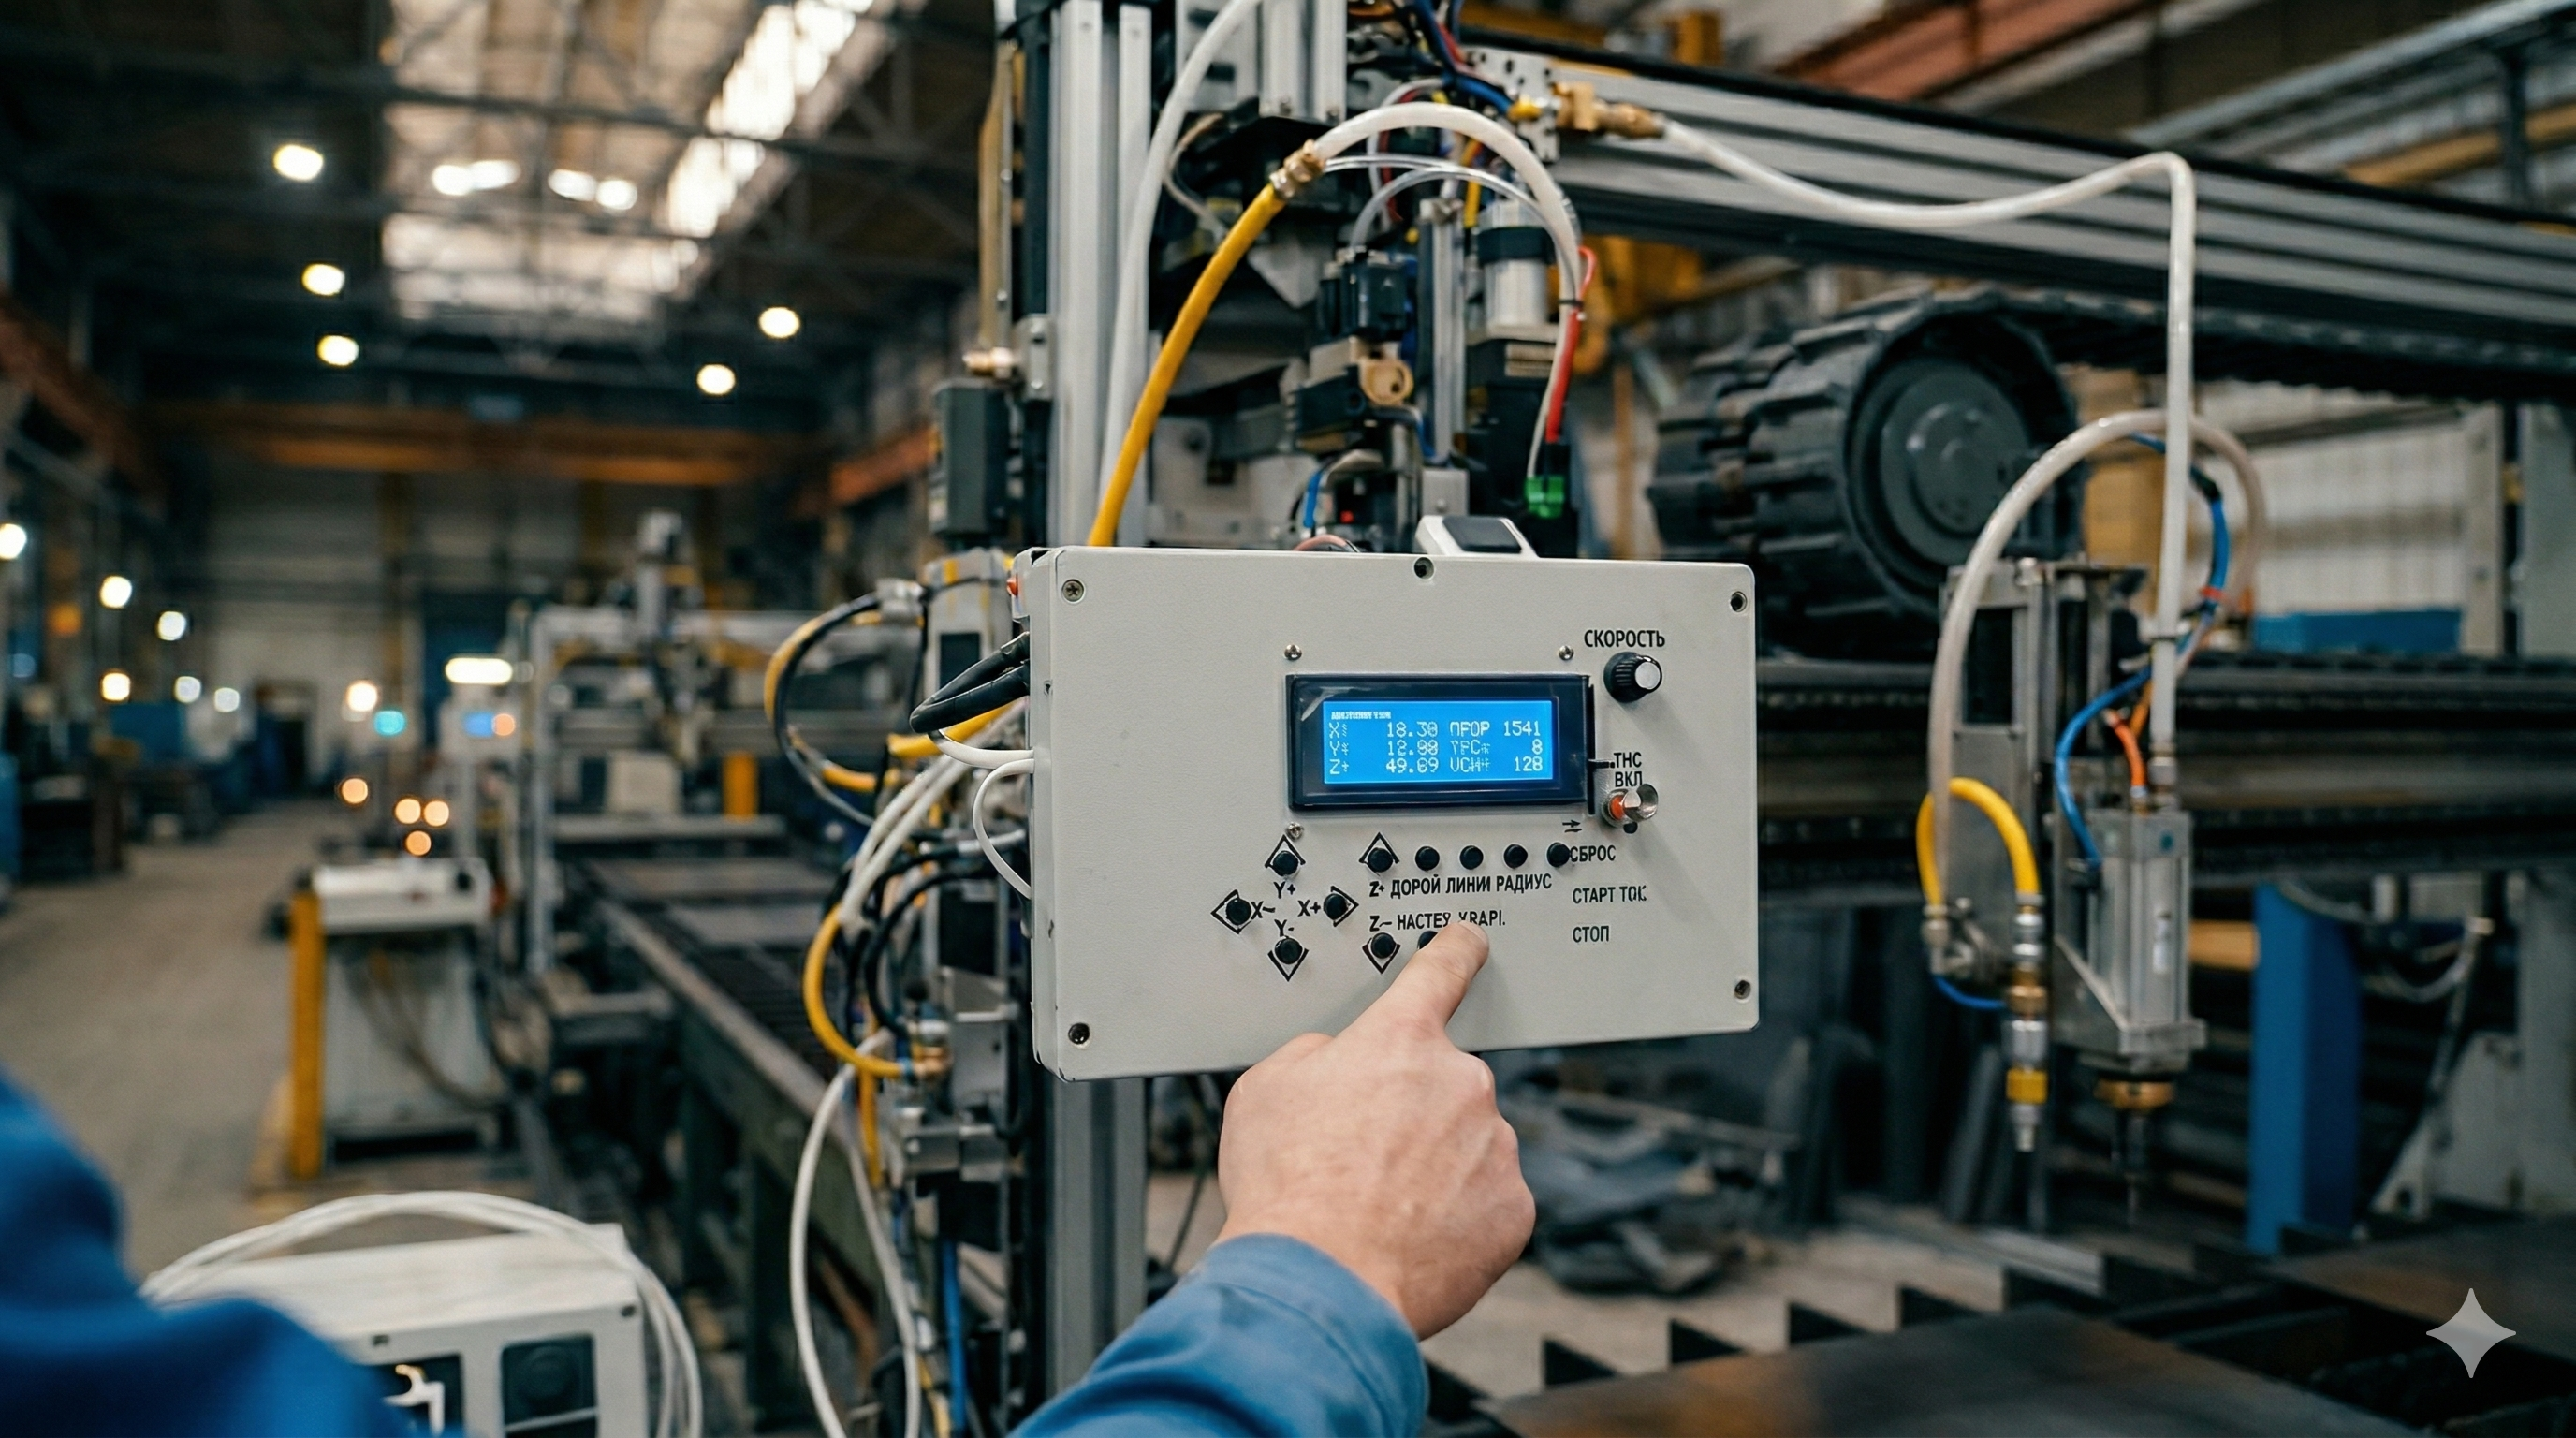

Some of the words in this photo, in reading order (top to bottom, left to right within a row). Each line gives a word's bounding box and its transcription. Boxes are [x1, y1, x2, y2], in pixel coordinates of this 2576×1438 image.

[1584, 629, 1665, 648] СКОРОСТЬ
[1503, 720, 1542, 737] 1541
[1515, 756, 1543, 771] 128
[1614, 752, 1642, 769] ТНС
[1615, 771, 1643, 787] ВКЛ
[1570, 844, 1616, 862] СБРОС
[1390, 874, 1441, 899] ДОРОЙ
[1497, 873, 1552, 895] РАДИУС
[1573, 887, 1616, 904] СТАРТ
[1573, 925, 1609, 943] СТОП
